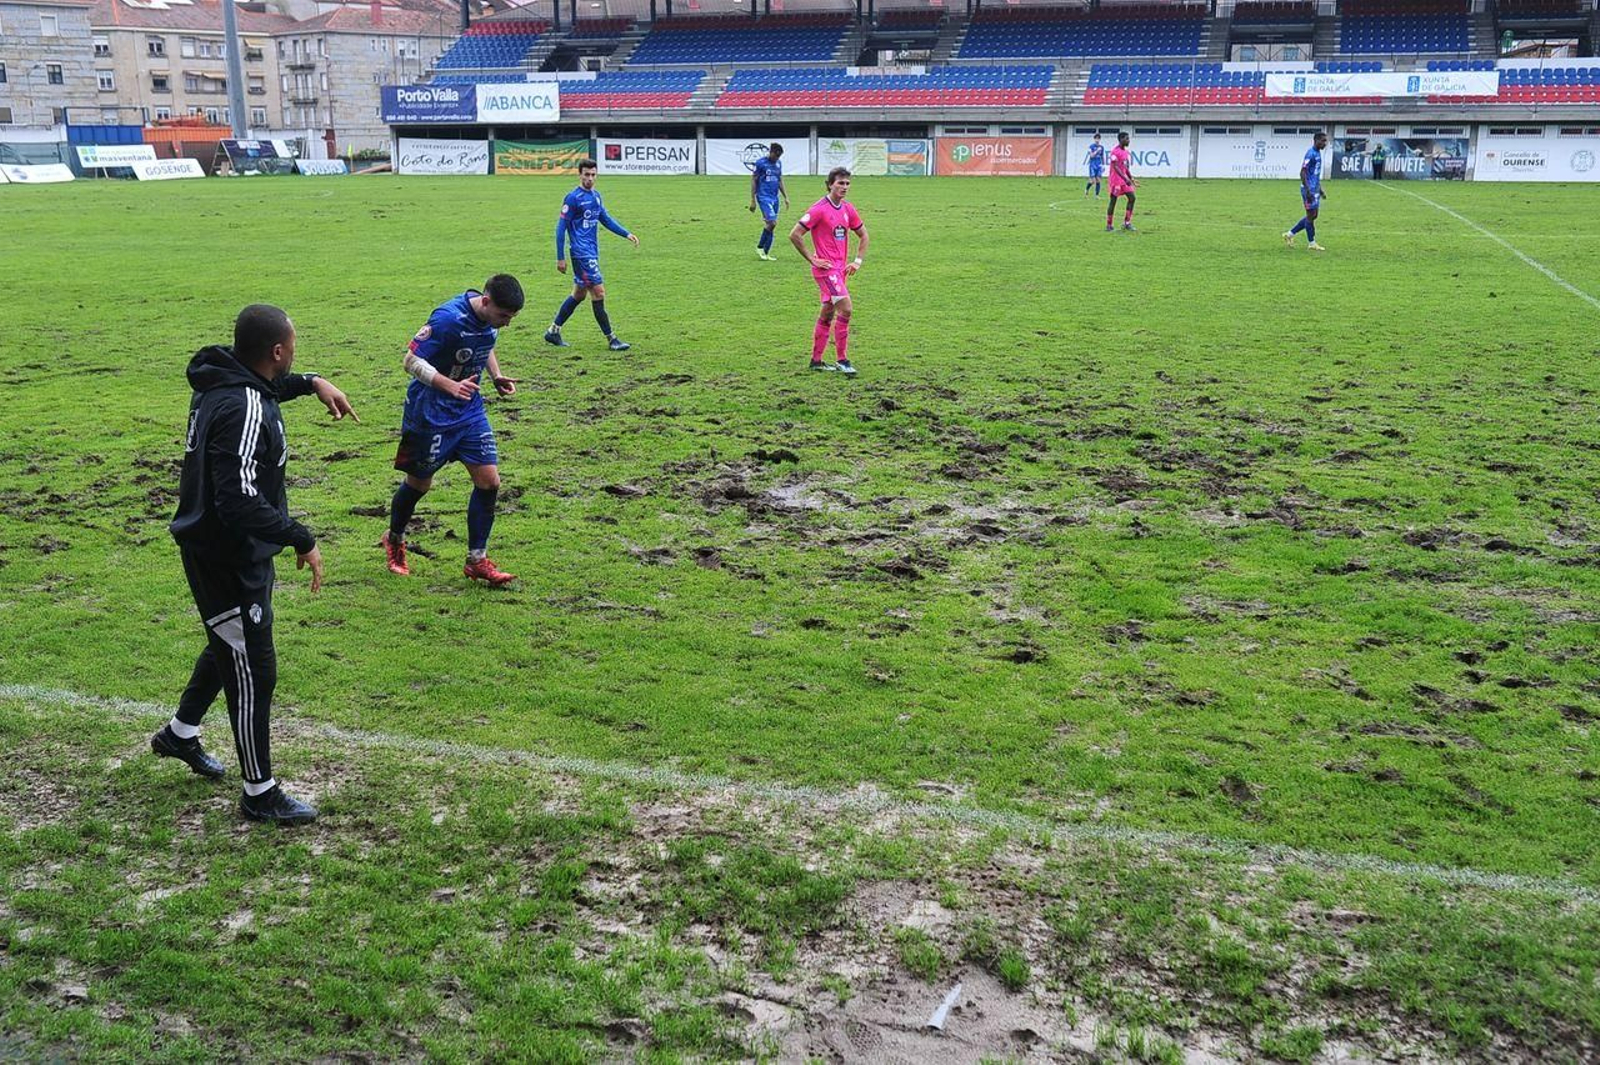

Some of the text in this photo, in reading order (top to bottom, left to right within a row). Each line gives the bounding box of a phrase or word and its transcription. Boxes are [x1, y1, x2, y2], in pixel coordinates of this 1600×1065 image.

[397, 88, 459, 102] Porto Valla
[436, 154, 453, 167] do
[624, 146, 690, 161] PERSAN
[1341, 156, 1360, 172] SAE
[1385, 154, 1426, 172] MÓVETE
[430, 434, 442, 454] 2
